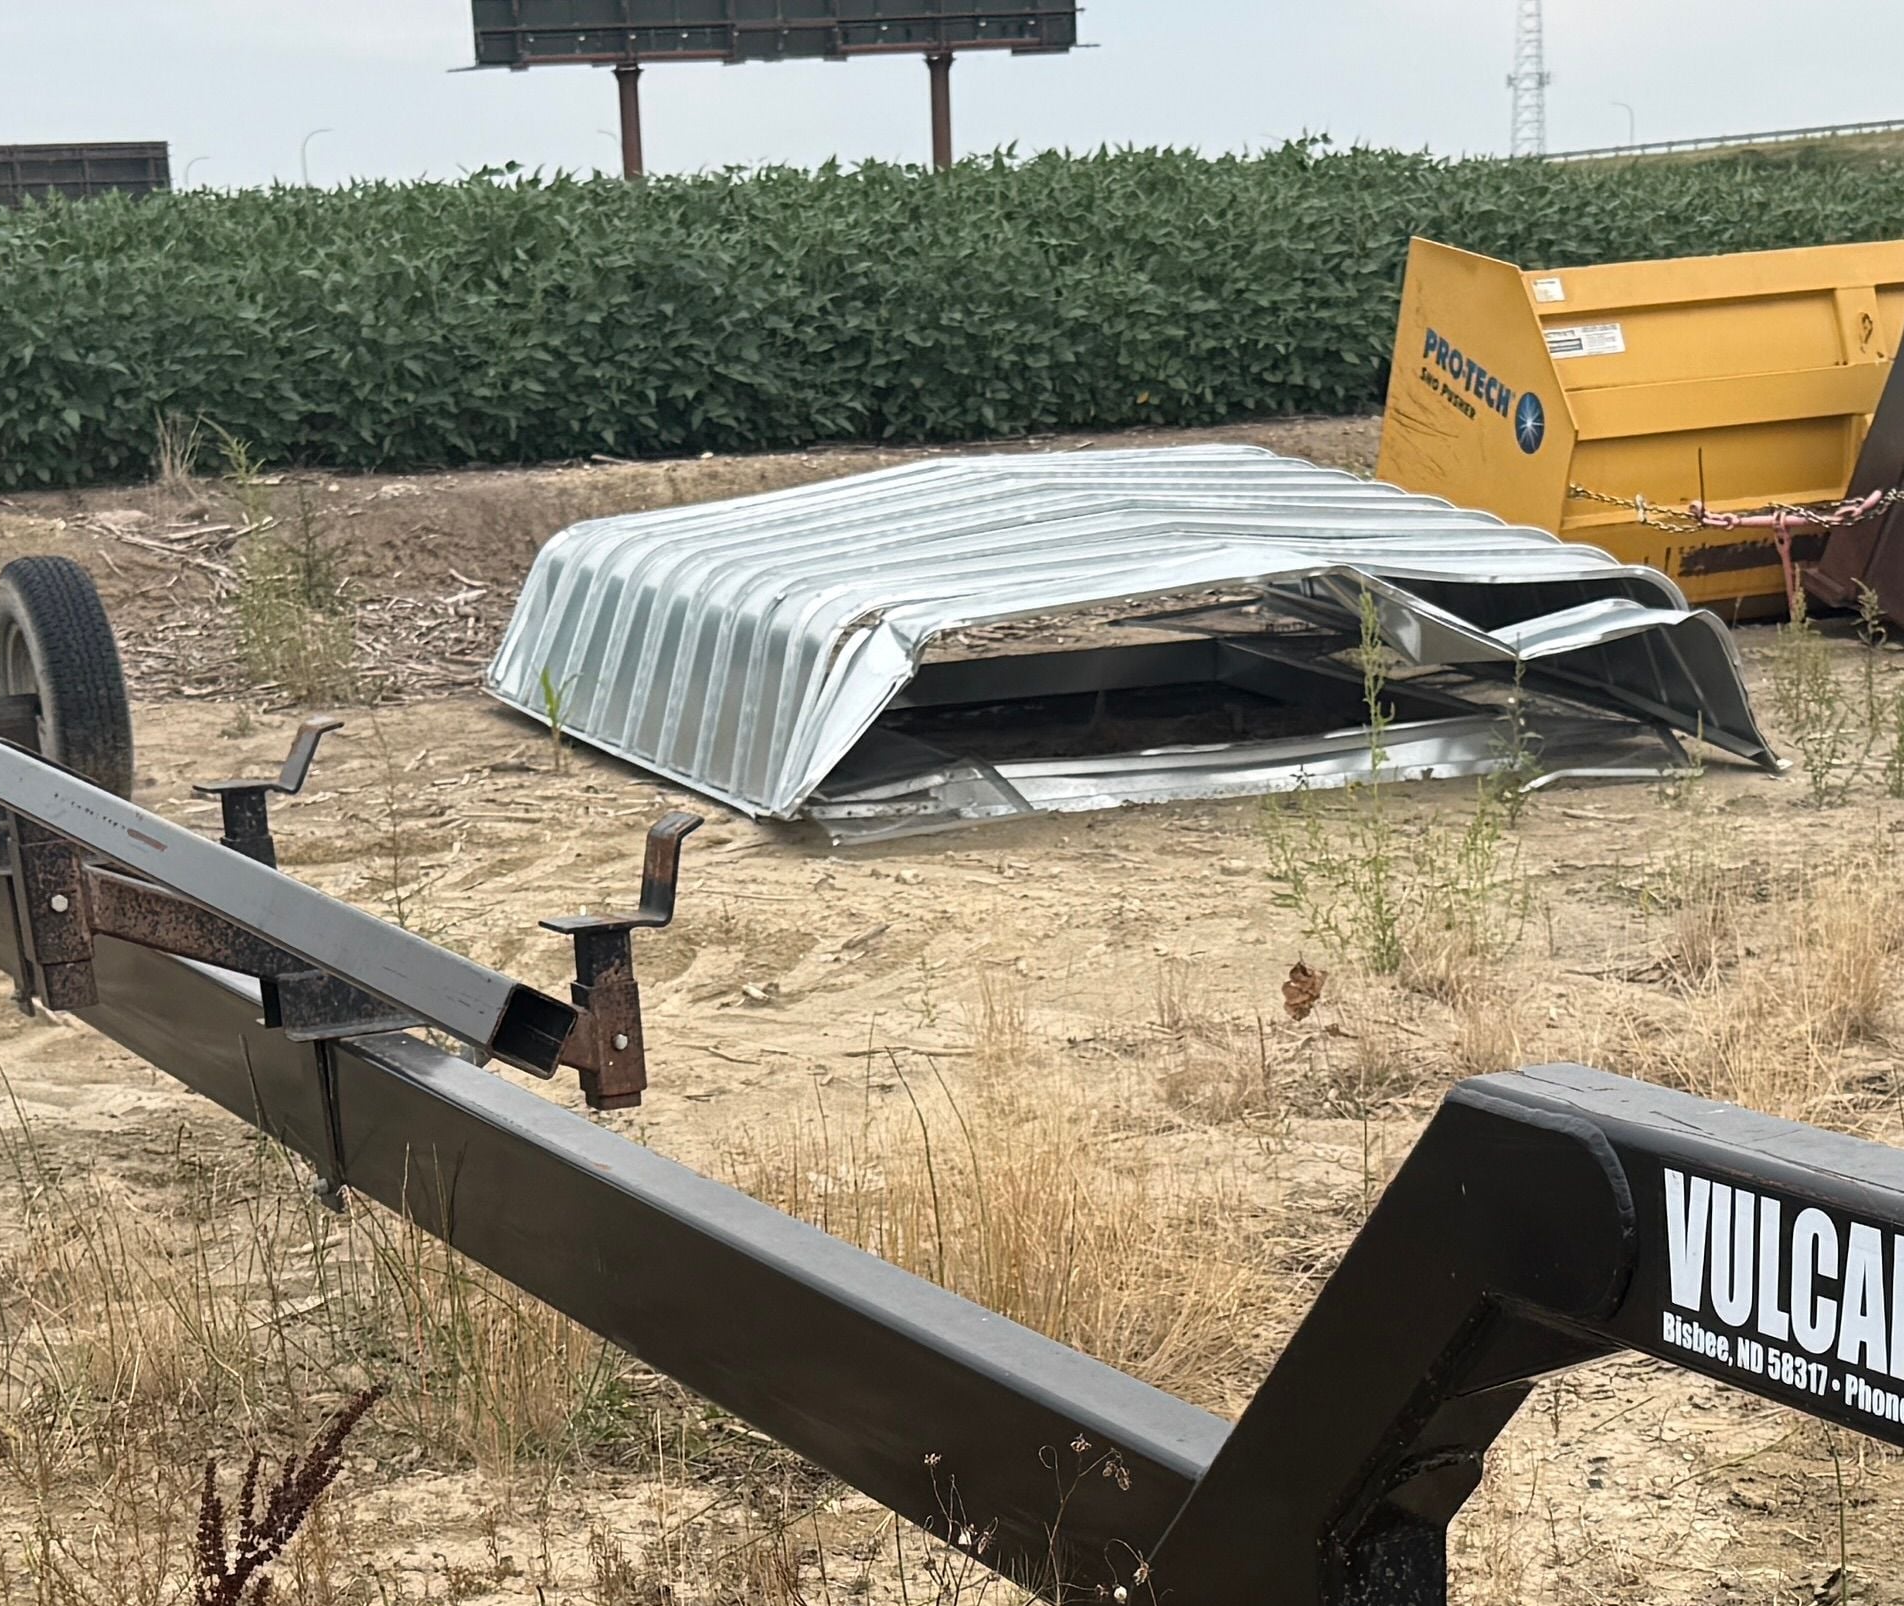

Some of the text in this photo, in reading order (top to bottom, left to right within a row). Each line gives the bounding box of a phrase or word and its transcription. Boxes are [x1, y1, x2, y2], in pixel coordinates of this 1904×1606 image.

[1662, 1311, 1733, 1366] Bisbee,
[1737, 1338, 1764, 1375] ND
[1767, 1349, 1828, 1397] 58317
